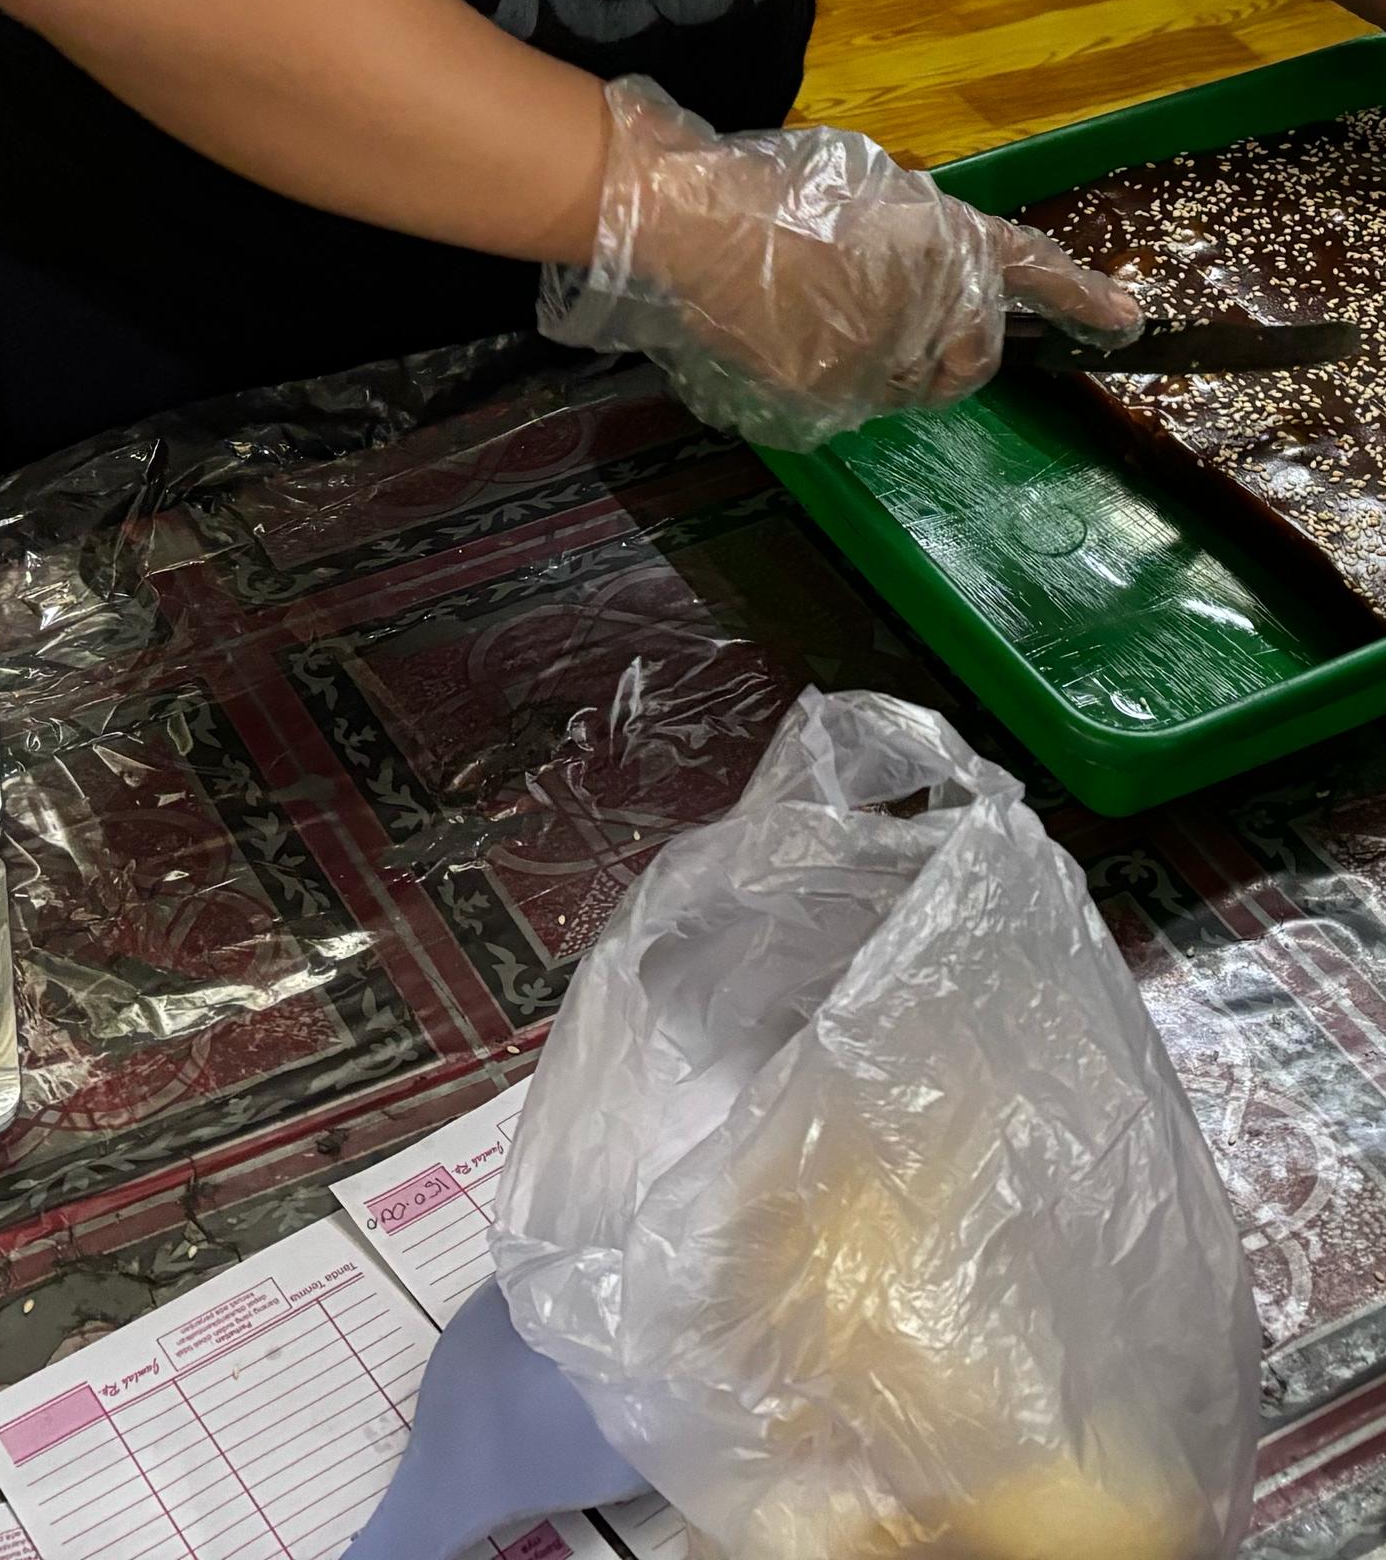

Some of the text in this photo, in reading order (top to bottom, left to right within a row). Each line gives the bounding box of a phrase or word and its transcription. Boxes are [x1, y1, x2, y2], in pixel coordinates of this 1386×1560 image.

[471, 1140, 504, 1167] Jumlah
[324, 1261, 358, 1282] Tanda
[97, 1357, 160, 1397] Jumlah Rp.
